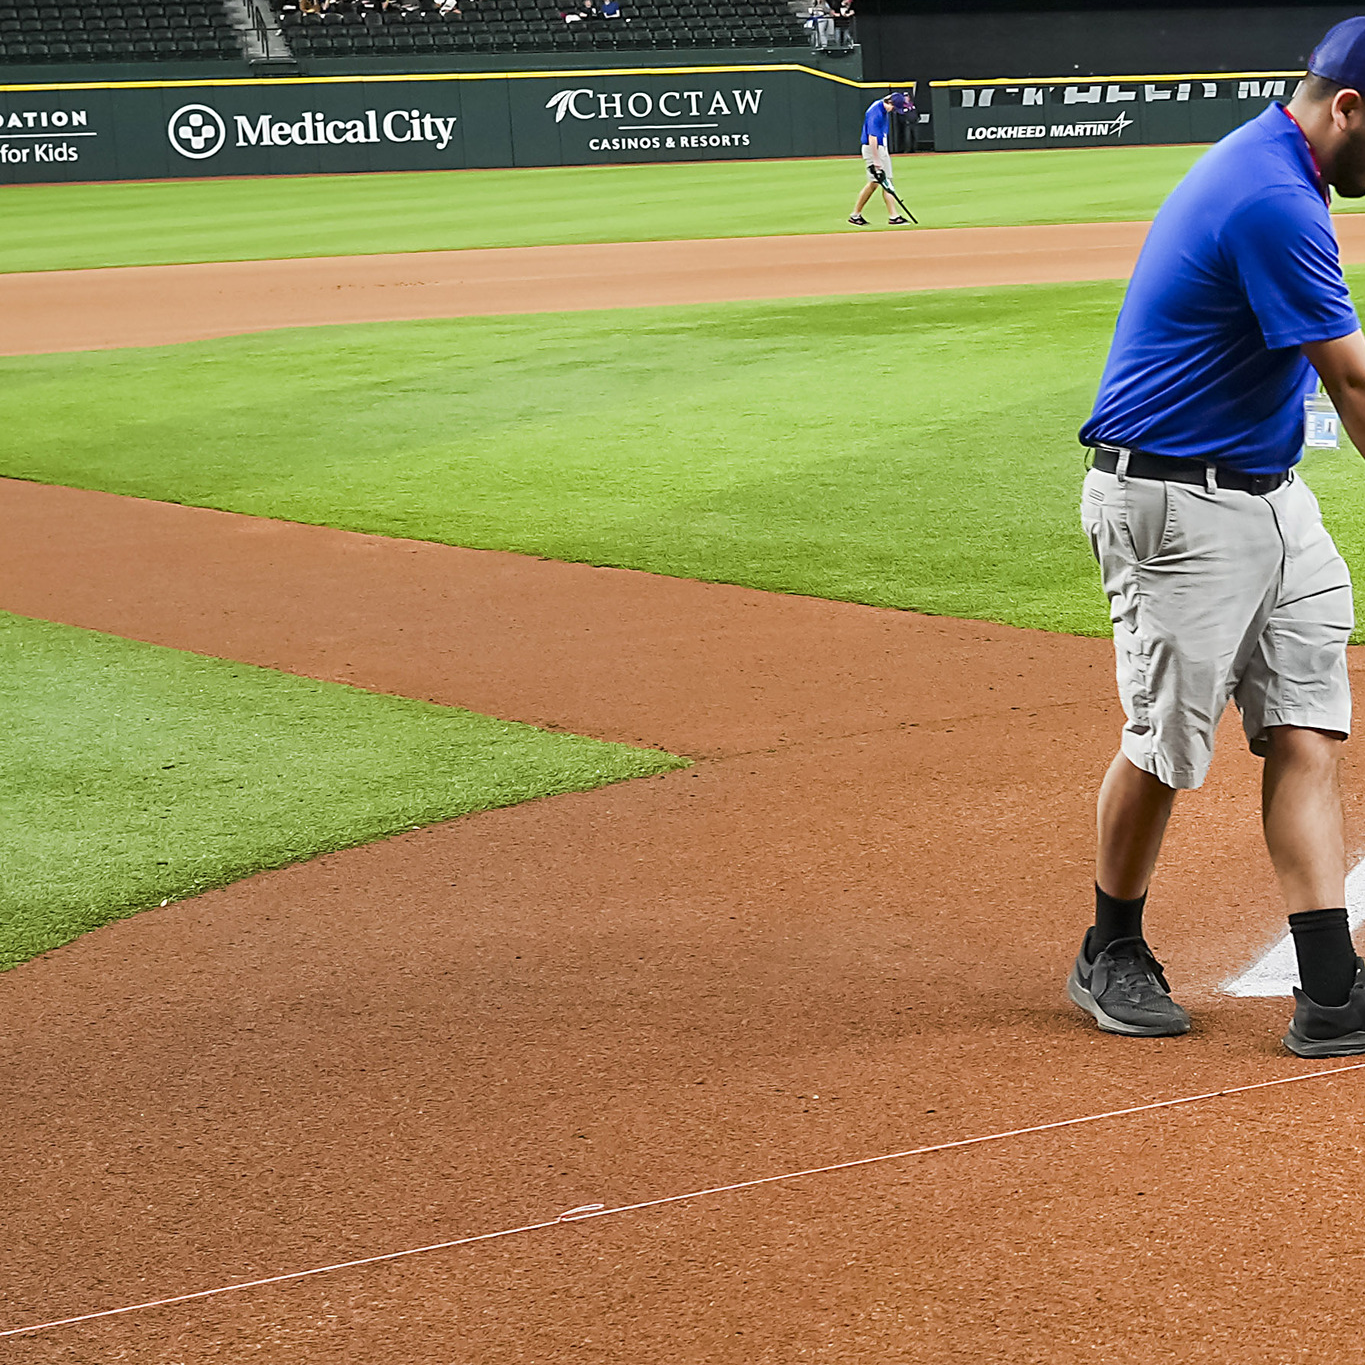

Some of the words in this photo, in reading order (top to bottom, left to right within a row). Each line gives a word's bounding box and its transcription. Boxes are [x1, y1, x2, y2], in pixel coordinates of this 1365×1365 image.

[567, 88, 763, 120] CHOCTAW
[0, 110, 87, 129] ATION
[234, 109, 380, 147] Medical
[383, 109, 457, 149] City
[966, 125, 1046, 140] LOCKHEED
[1050, 122, 1110, 138] MARTIN
[0, 143, 30, 163] for
[34, 142, 79, 162] Kids
[588, 136, 660, 151] CASINOS
[665, 136, 676, 149] &
[680, 134, 751, 149] RESORTS
